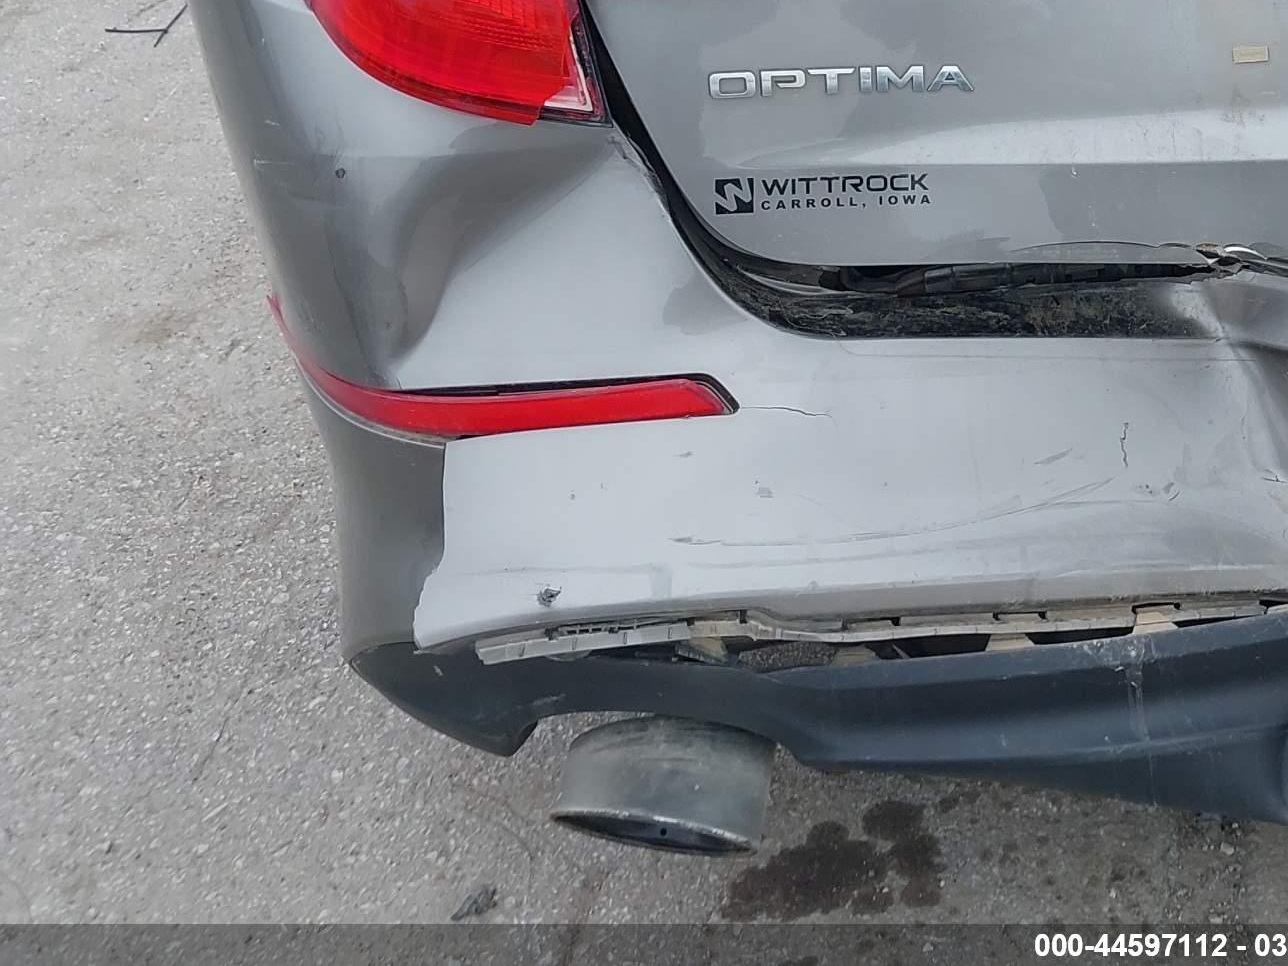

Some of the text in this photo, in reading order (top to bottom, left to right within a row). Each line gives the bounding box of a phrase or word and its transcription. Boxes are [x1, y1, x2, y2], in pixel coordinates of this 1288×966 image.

[708, 65, 975, 99] OPTIMA
[761, 173, 930, 196] WITTROCK
[761, 194, 931, 211] CARROLL, IOWA
